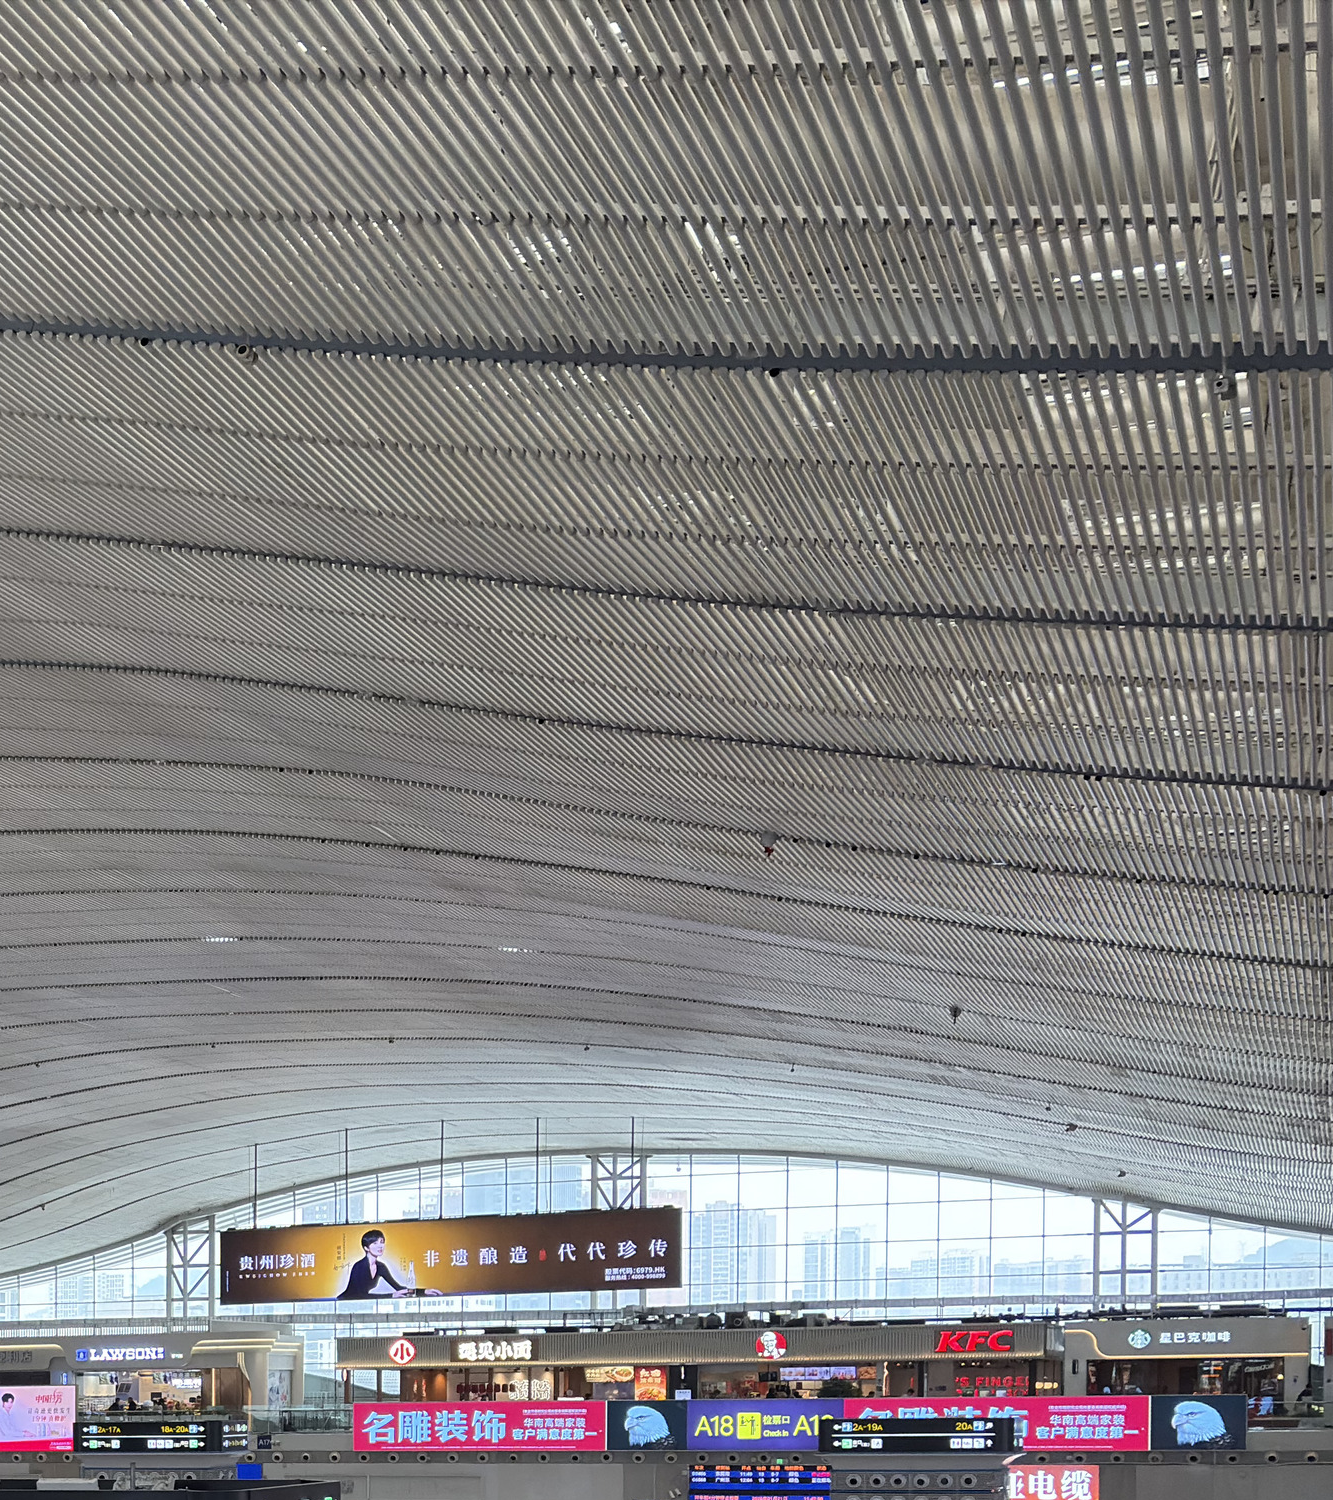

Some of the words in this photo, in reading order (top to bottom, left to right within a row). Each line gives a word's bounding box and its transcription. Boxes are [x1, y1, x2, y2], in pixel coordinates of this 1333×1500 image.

[935, 1329, 1013, 1353] KFC
[1159, 1331, 1231, 1344] 星巴克咖啡
[90, 1348, 157, 1362] LAWSON
[458, 1339, 533, 1362] 遇见小面
[523, 1418, 586, 1428] 华南高端家装
[694, 1414, 734, 1437] A18
[762, 1415, 790, 1425] 检票口
[793, 1414, 834, 1437] A1
[1049, 1414, 1125, 1426] 华南高端家装
[161, 1425, 189, 1433] 18A-20A
[362, 1409, 506, 1444] 名雕装饰
[852, 1422, 883, 1432] 2A-19A
[955, 1422, 973, 1431] 20A
[1036, 1426, 1139, 1439] 客户满意度第一
[513, 1428, 598, 1440] 客户满意度第一
[763, 1429, 781, 1437] Check
